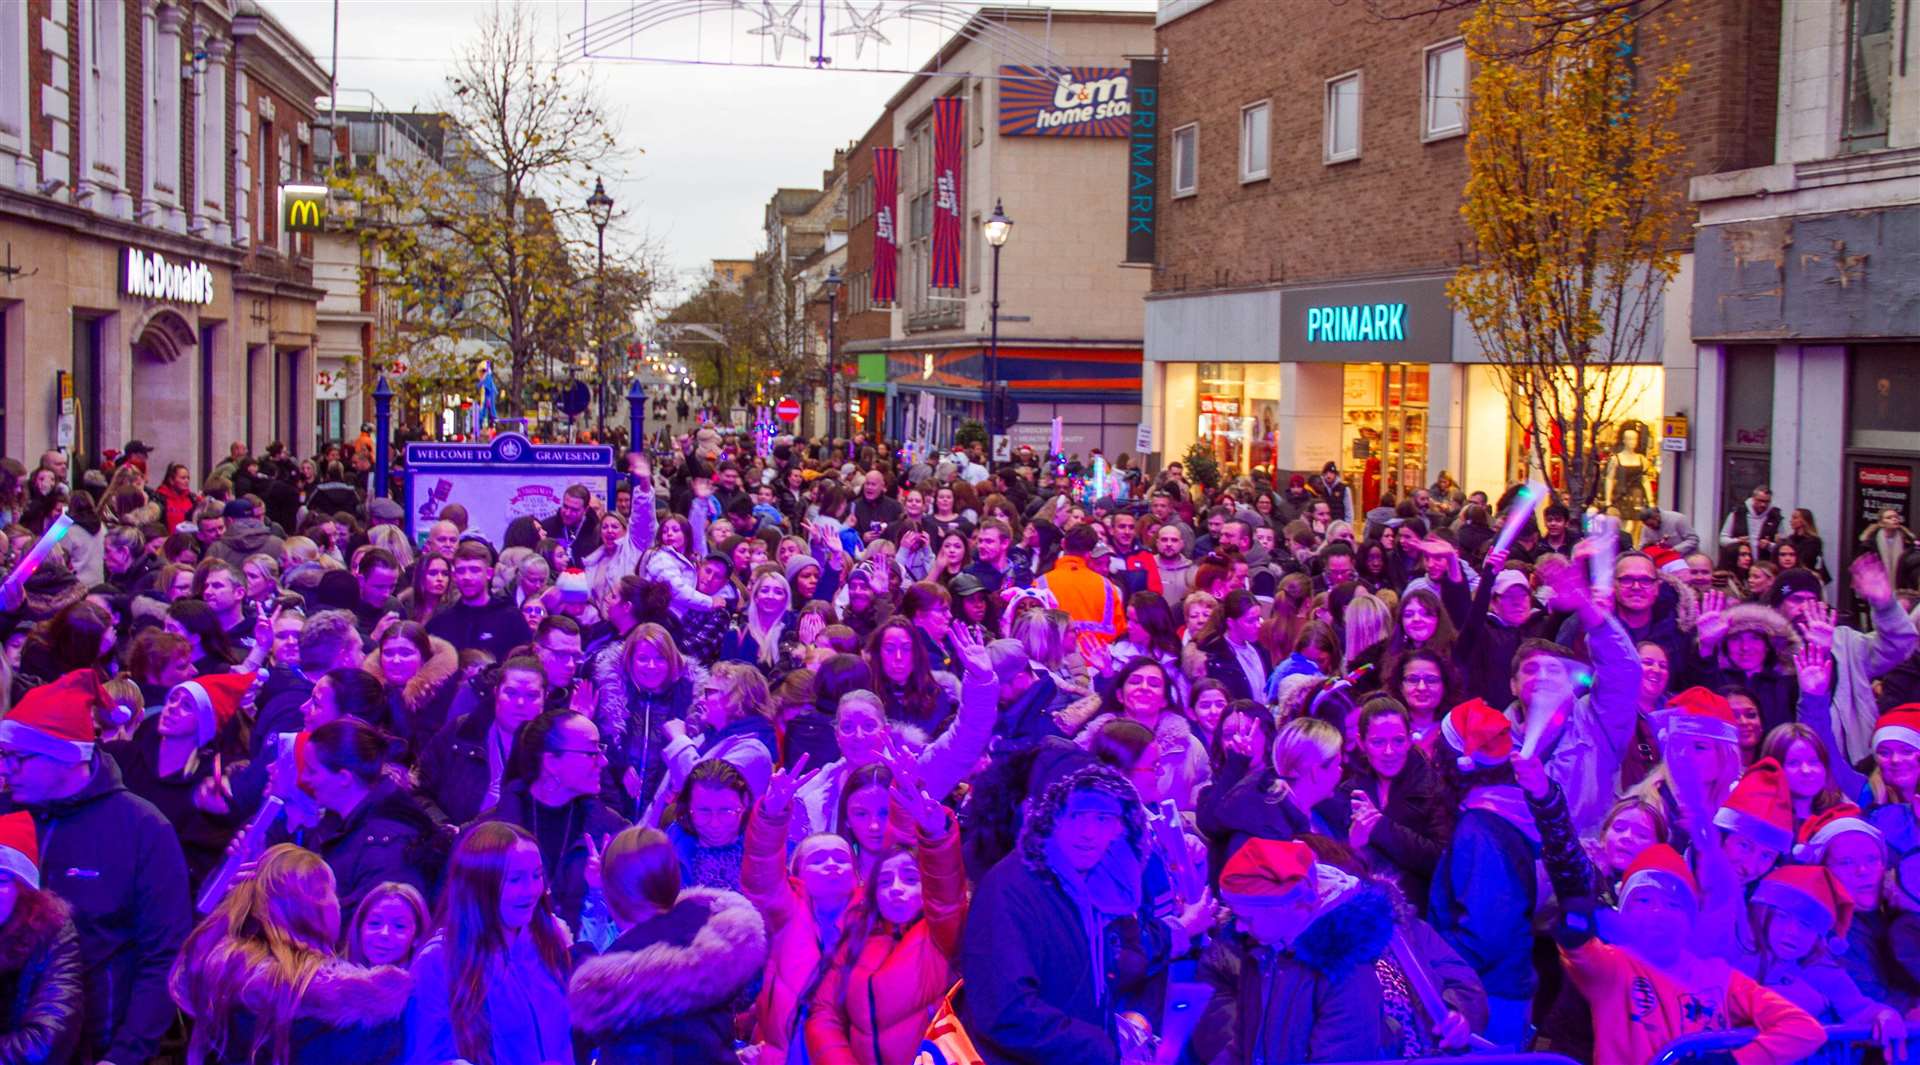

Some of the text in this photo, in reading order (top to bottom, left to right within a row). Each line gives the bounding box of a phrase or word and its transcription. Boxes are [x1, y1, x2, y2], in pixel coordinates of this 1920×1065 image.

[1036, 105, 1094, 128] home
[1130, 87, 1156, 235] PRIMARK
[128, 246, 214, 305] McDonald's
[1308, 303, 1404, 342] PRIMARK
[417, 449, 600, 461] WELCOME TO GRAVESEND
